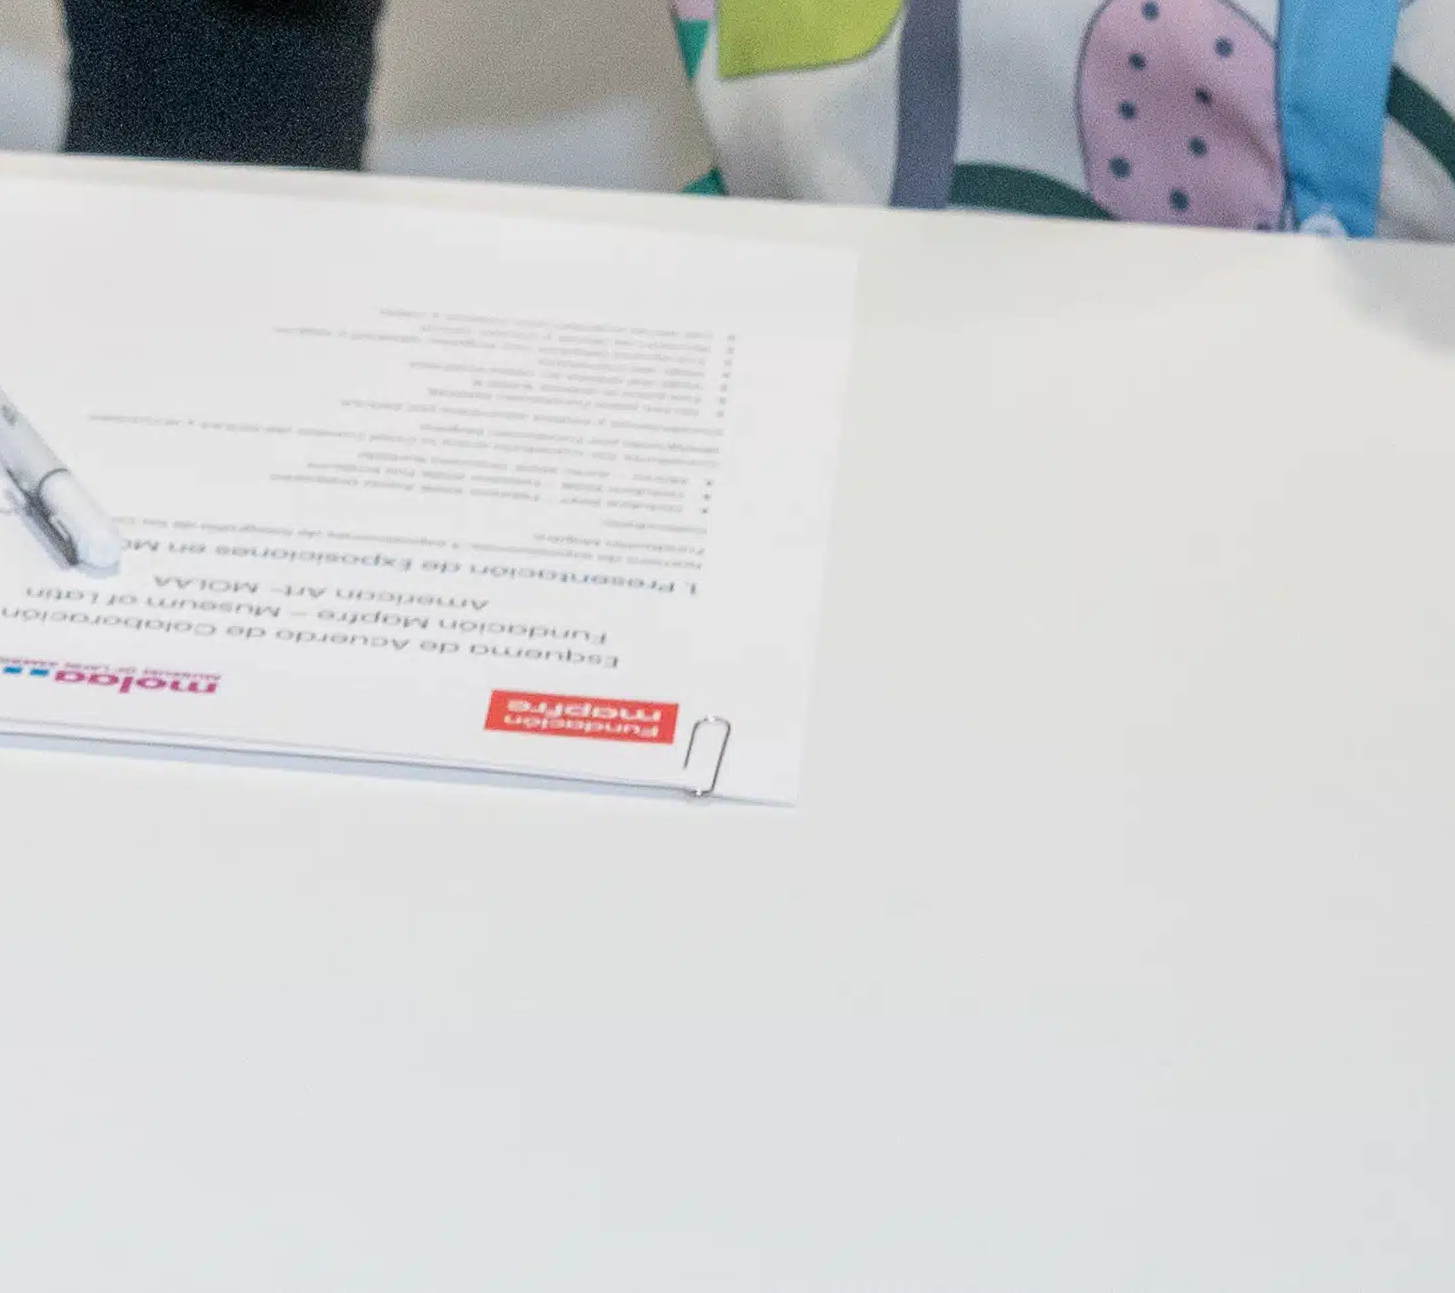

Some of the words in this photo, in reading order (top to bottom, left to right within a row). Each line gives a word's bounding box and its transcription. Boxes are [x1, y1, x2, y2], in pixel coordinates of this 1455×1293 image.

[168, 542, 207, 556] en
[215, 545, 413, 571] Exposiciones
[421, 561, 461, 575] de
[468, 564, 676, 591] Presentación
[24, 586, 99, 605] Latin
[152, 575, 260, 594] MOLAA
[105, 594, 137, 607] of
[145, 596, 282, 618] Museum
[335, 589, 490, 612] American
[0, 606, 217, 636] Colaboración
[316, 608, 430, 628] Mapfre
[225, 626, 266, 640] de
[274, 630, 411, 651] Acuerdo
[437, 619, 608, 645] Fundación
[418, 640, 460, 655] de
[469, 643, 620, 669] Esquema
[54, 669, 218, 696] molaa
[505, 699, 662, 724] mapfre
[502, 714, 659, 739] Fundación
